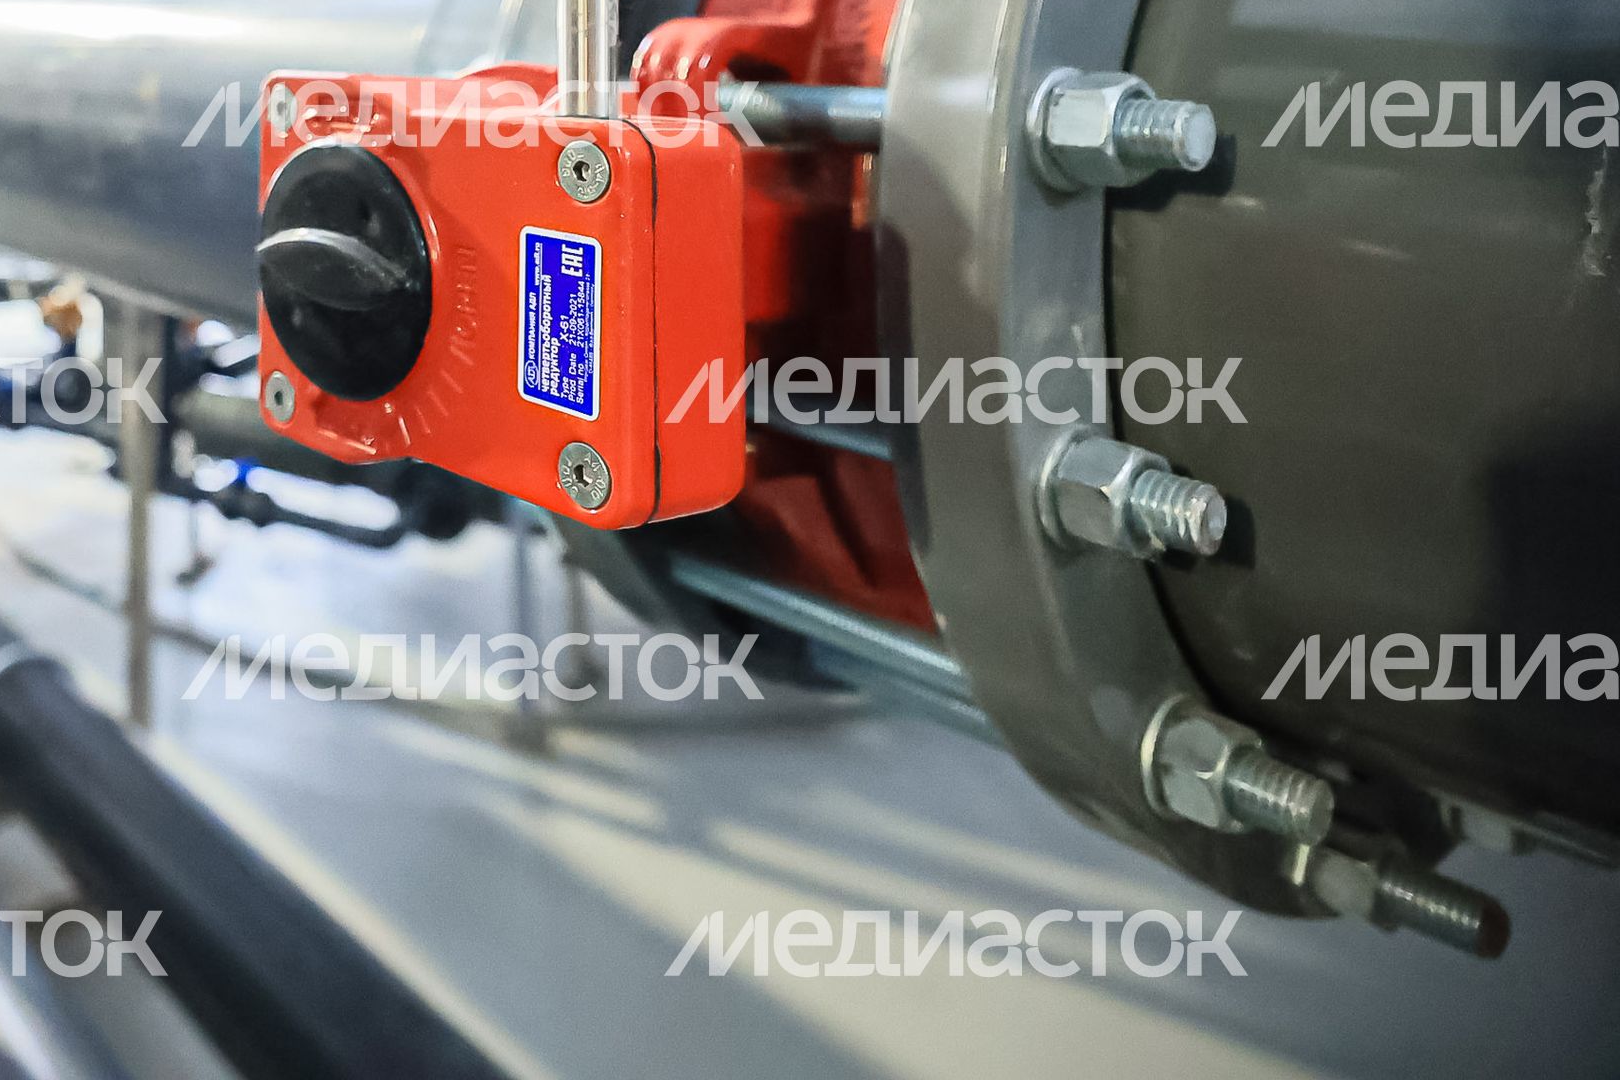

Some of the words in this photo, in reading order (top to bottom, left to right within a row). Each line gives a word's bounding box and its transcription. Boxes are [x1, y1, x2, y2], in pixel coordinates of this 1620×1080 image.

[569, 294, 577, 346] 21-09-2021
[540, 273, 553, 394] четвертьоборотный
[550, 337, 561, 397] редуктор
[569, 353, 577, 375] Date
[578, 363, 584, 376] no
[561, 376, 569, 400] Type
[568, 379, 576, 402] Prod
[576, 377, 585, 404] Serial
